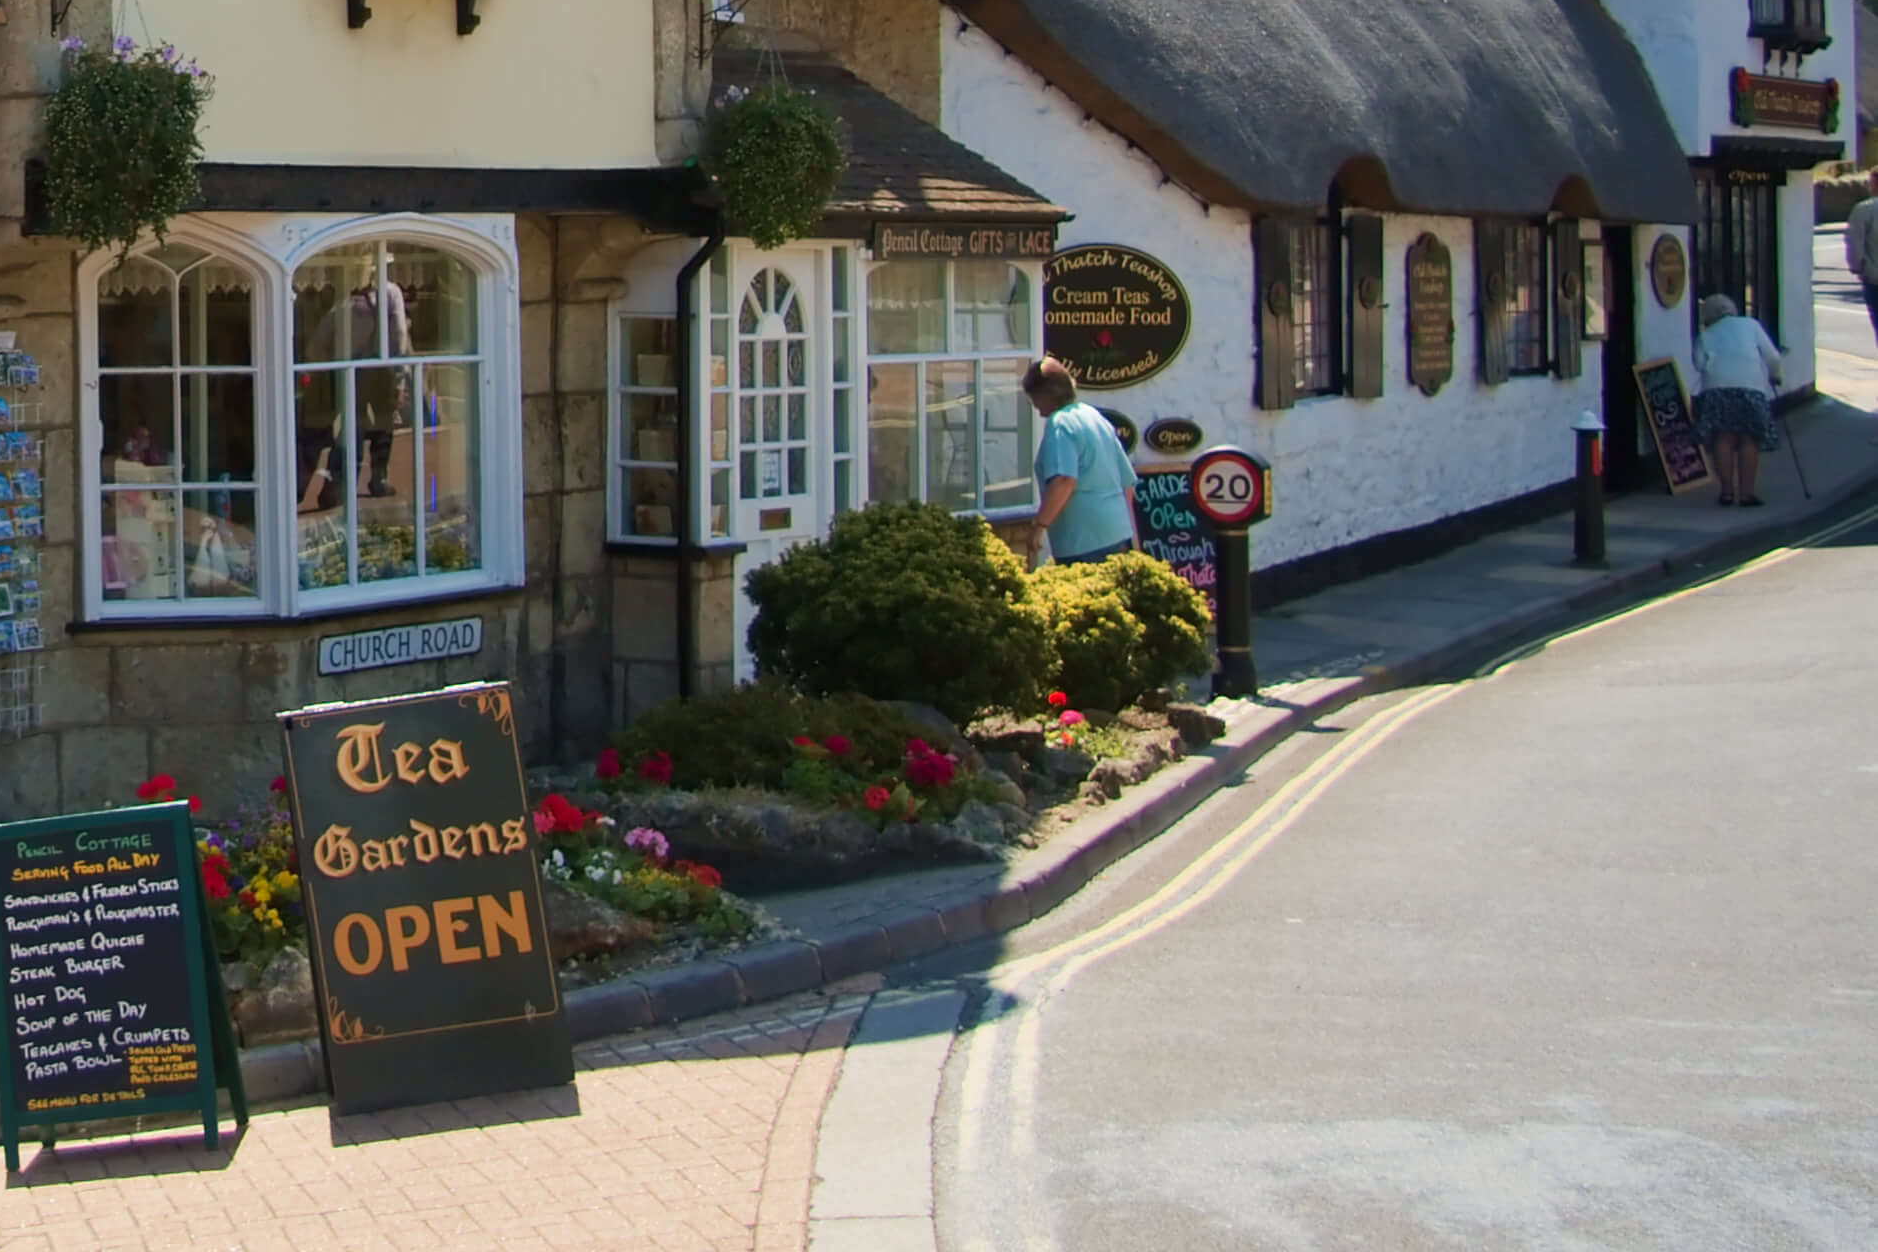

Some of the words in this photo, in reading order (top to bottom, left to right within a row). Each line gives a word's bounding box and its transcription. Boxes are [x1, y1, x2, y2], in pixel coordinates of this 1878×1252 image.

[882, 228, 918, 259] Pencil
[920, 228, 963, 256] Cottage
[969, 230, 1003, 254] GIFTS
[1018, 230, 1050, 254] LACE
[1052, 249, 1117, 277] Thatch
[1122, 254, 1178, 302] Teashop
[1052, 286, 1109, 305] Cream
[1112, 286, 1151, 305] Teas
[1044, 306, 1125, 326] omemade
[1129, 308, 1171, 326] Food
[1086, 350, 1158, 380] Licensed
[1157, 428, 1194, 446] Open
[1134, 473, 1190, 513] GARDE
[1205, 473, 1251, 501] 20
[329, 631, 411, 668] CHURCH
[421, 623, 475, 655] ROAD
[335, 721, 471, 794] Tea
[17, 842, 63, 859] PENCIL
[75, 832, 152, 851] COTTAGE
[313, 815, 529, 879] Gardens
[11, 866, 69, 882] SERVING
[73, 860, 104, 875] FOOD
[107, 856, 131, 871] ALL
[132, 852, 160, 868] DAY
[4, 891, 79, 909] SANDWICHES
[91, 883, 137, 899] FRENCH
[137, 878, 179, 895] STICKS
[6, 910, 80, 932] PLOUGHMAN'S
[333, 889, 533, 977] OPEN
[10, 938, 85, 959] HOMEMADE
[91, 932, 145, 951] QUICHE
[9, 966, 56, 984] STEAK
[65, 955, 125, 975] BURGER
[14, 993, 46, 1010] HOT
[54, 985, 87, 1005] DOG
[16, 1016, 56, 1036] SOUP
[62, 1012, 79, 1026] OF
[84, 1008, 112, 1023] THE
[117, 1000, 147, 1020] DAY
[20, 1037, 93, 1061] TEACAKES
[112, 1027, 190, 1046] CRUMPETS
[26, 1062, 68, 1082] PASTA
[71, 1053, 123, 1070] BOWL
[79, 1093, 99, 1104] FOR
